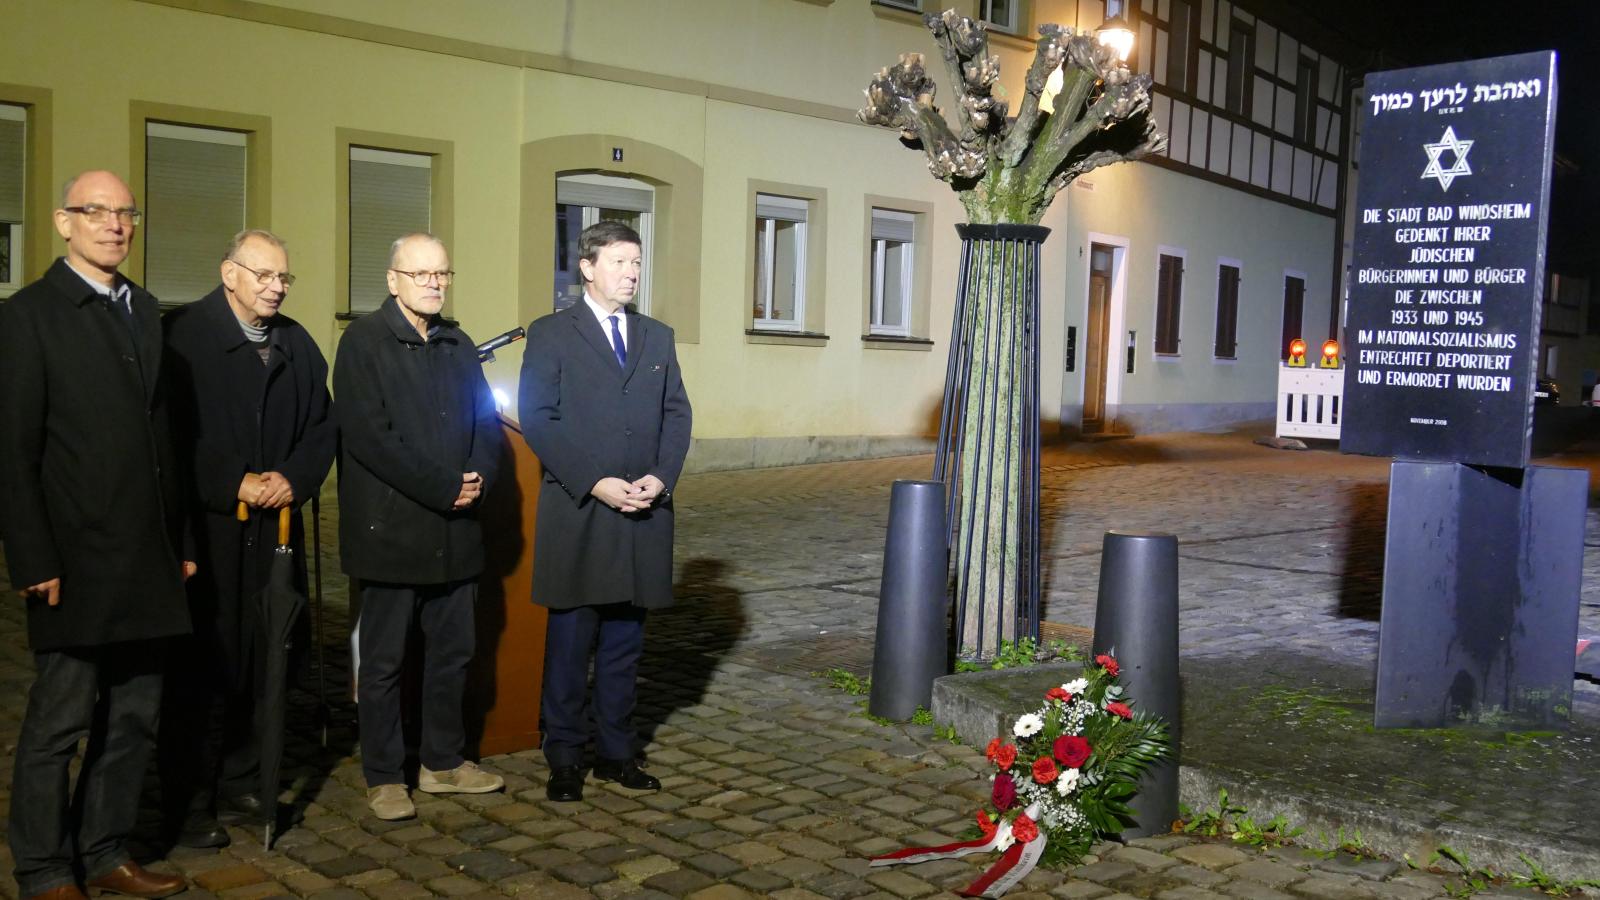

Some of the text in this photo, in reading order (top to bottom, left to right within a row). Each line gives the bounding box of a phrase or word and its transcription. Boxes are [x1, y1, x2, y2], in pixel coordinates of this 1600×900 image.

[1369, 78, 1542, 116] ואהבת לרעך כמוך
[1363, 203, 1531, 224] DIE STADT BAD WINDSHEIM
[1395, 226, 1491, 243] GEDENKT IHRER
[1408, 246, 1475, 263] JÜDISCHEN
[1358, 266, 1526, 284] BÜRGERINNEN UND BÜRGER
[1395, 289, 1482, 305] DIE ZWISCHEN
[1391, 310, 1484, 326] 1933 UND 1945
[1358, 330, 1517, 349] IM NATIONALSOZIALISMUS
[1359, 350, 1512, 370] ENTRECHTET DEPORTIERT
[1358, 369, 1511, 392] UND ERMORDET WURDEN
[1410, 417, 1434, 425] NOVEMBER
